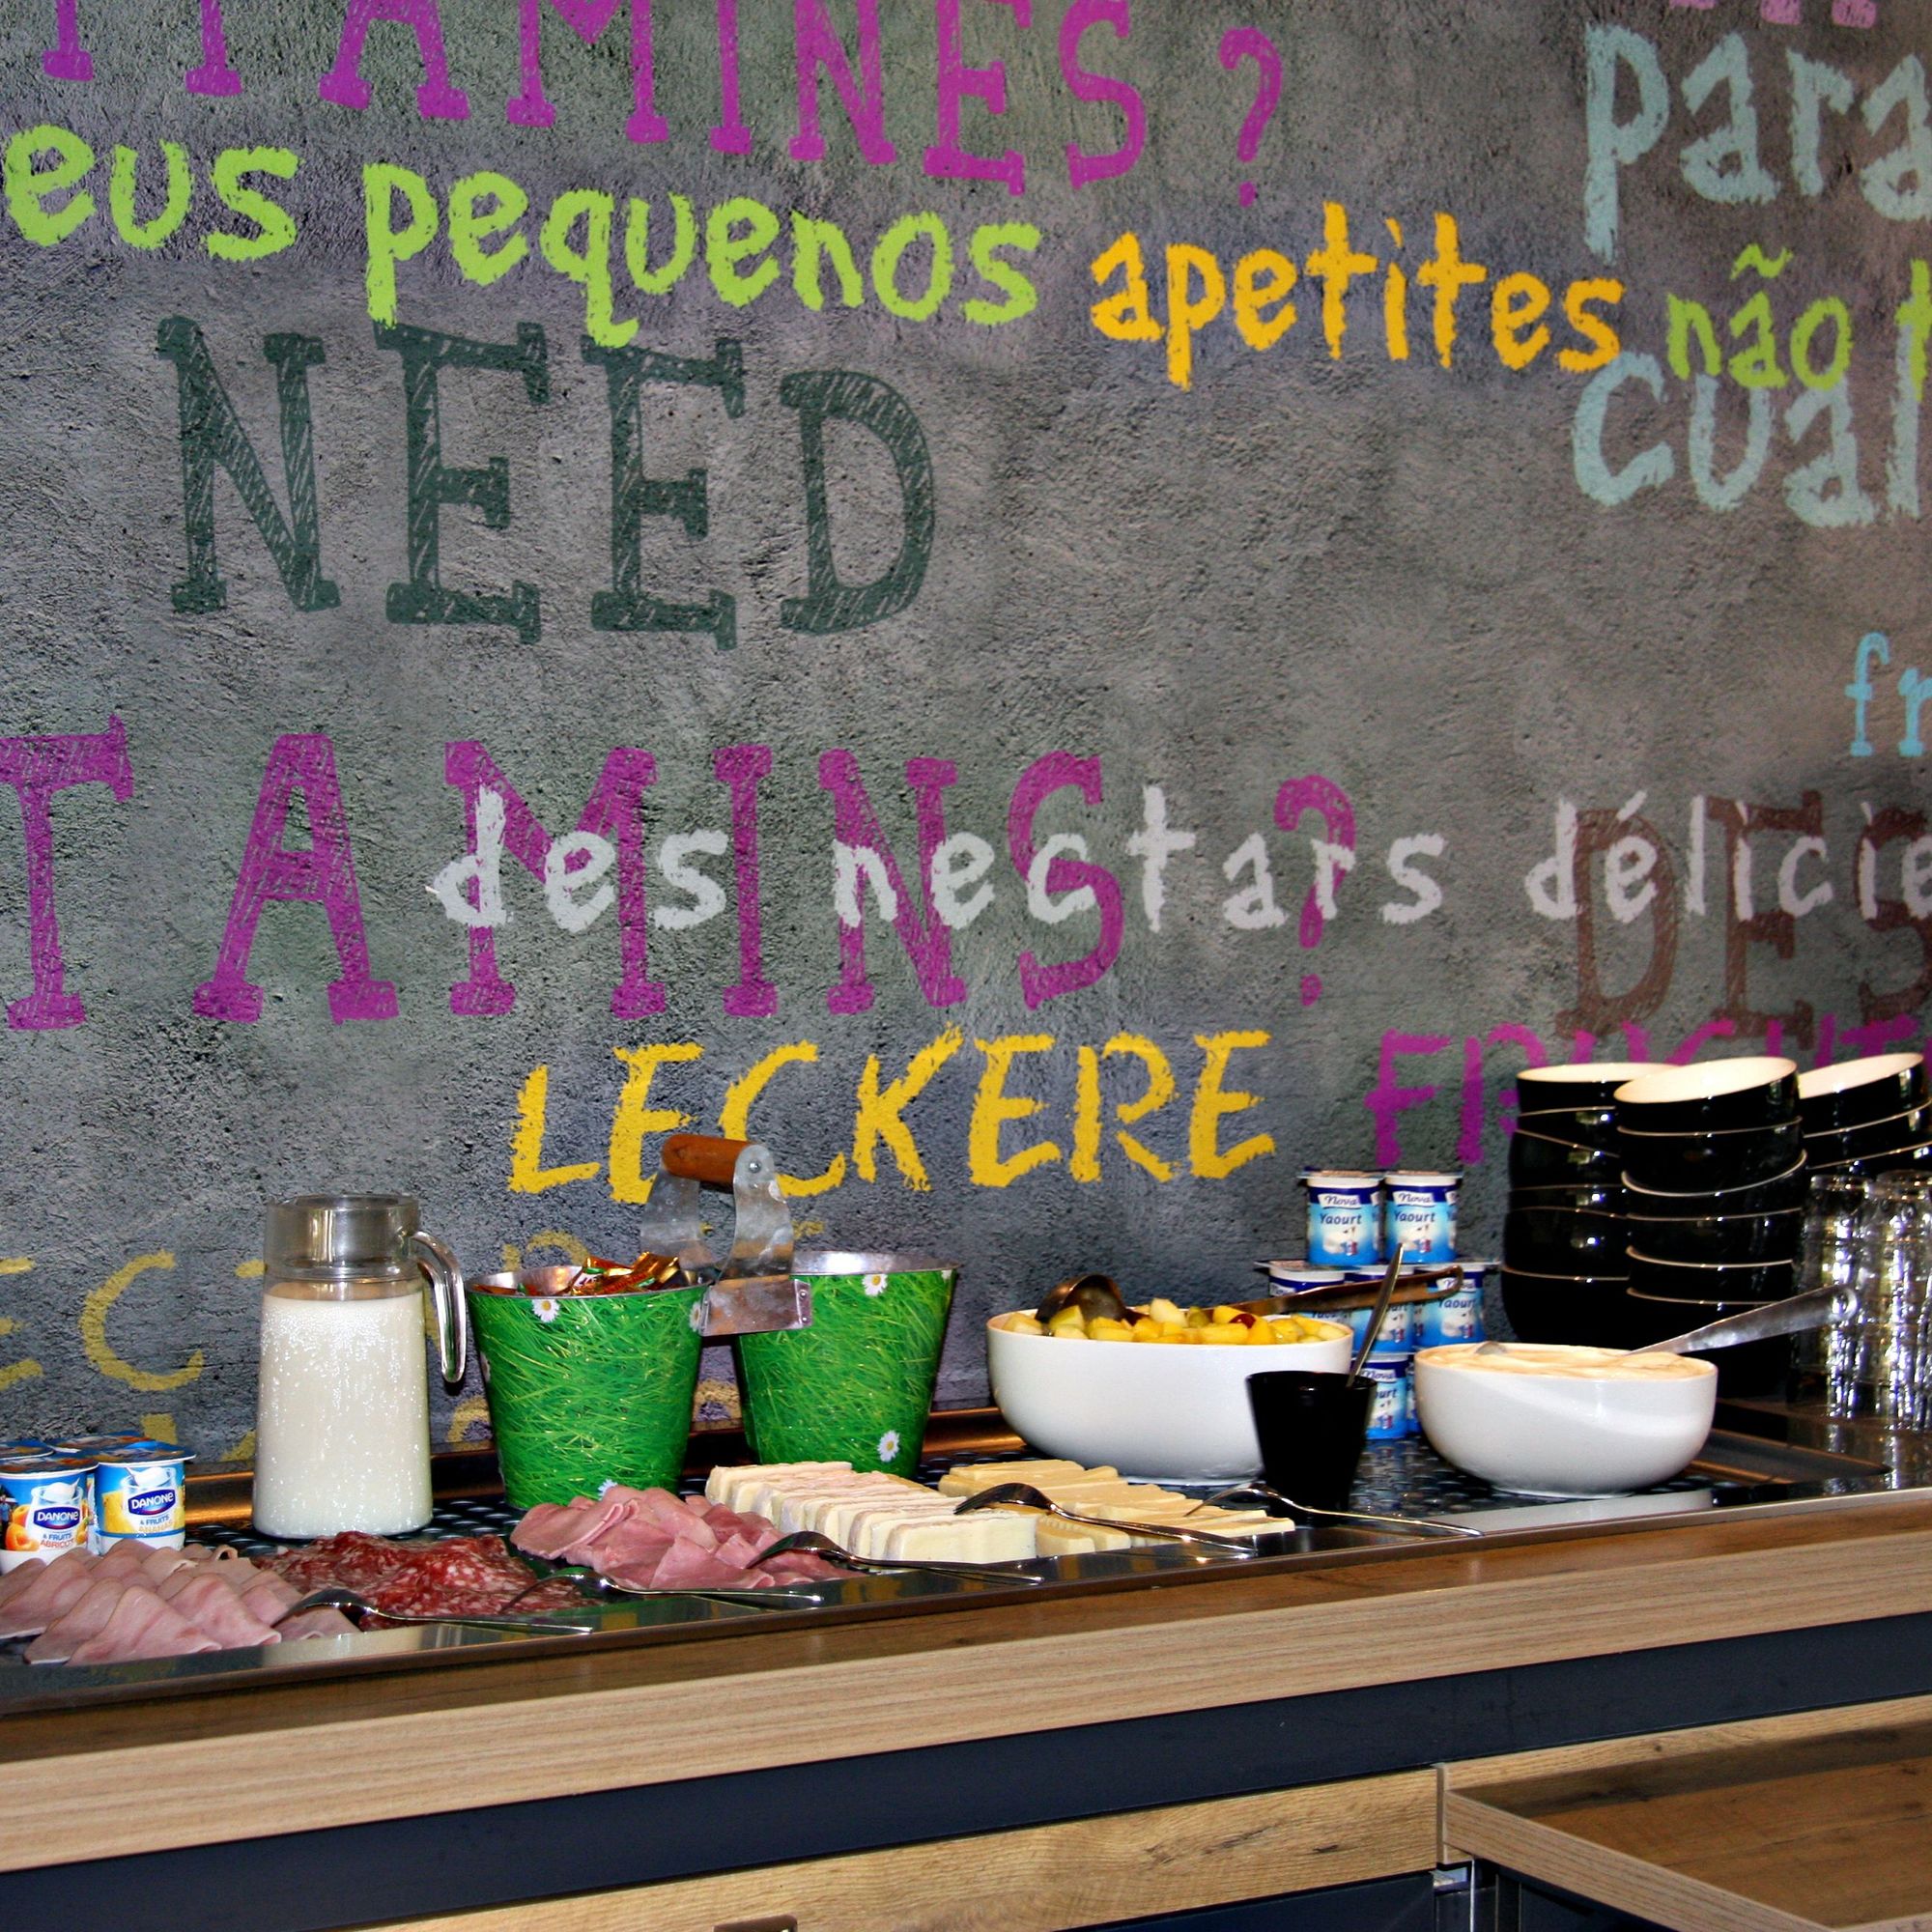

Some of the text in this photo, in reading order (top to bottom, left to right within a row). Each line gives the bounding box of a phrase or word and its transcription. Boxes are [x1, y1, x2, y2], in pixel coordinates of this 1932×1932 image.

[1218, 27, 1283, 207] ?
[1582, 21, 1932, 265] para
[3, 124, 303, 262] eus
[362, 162, 1040, 349] pequenos
[1090, 200, 1625, 391] apetites
[1666, 243, 1853, 392] não
[156, 314, 935, 652] NEED
[425, 784, 728, 933] des
[829, 784, 1445, 933] nectars
[507, 1020, 1275, 1205] LECKERE
[1320, 1213, 1362, 1225] Yaourt
[1394, 1211, 1435, 1222] Yaourt
